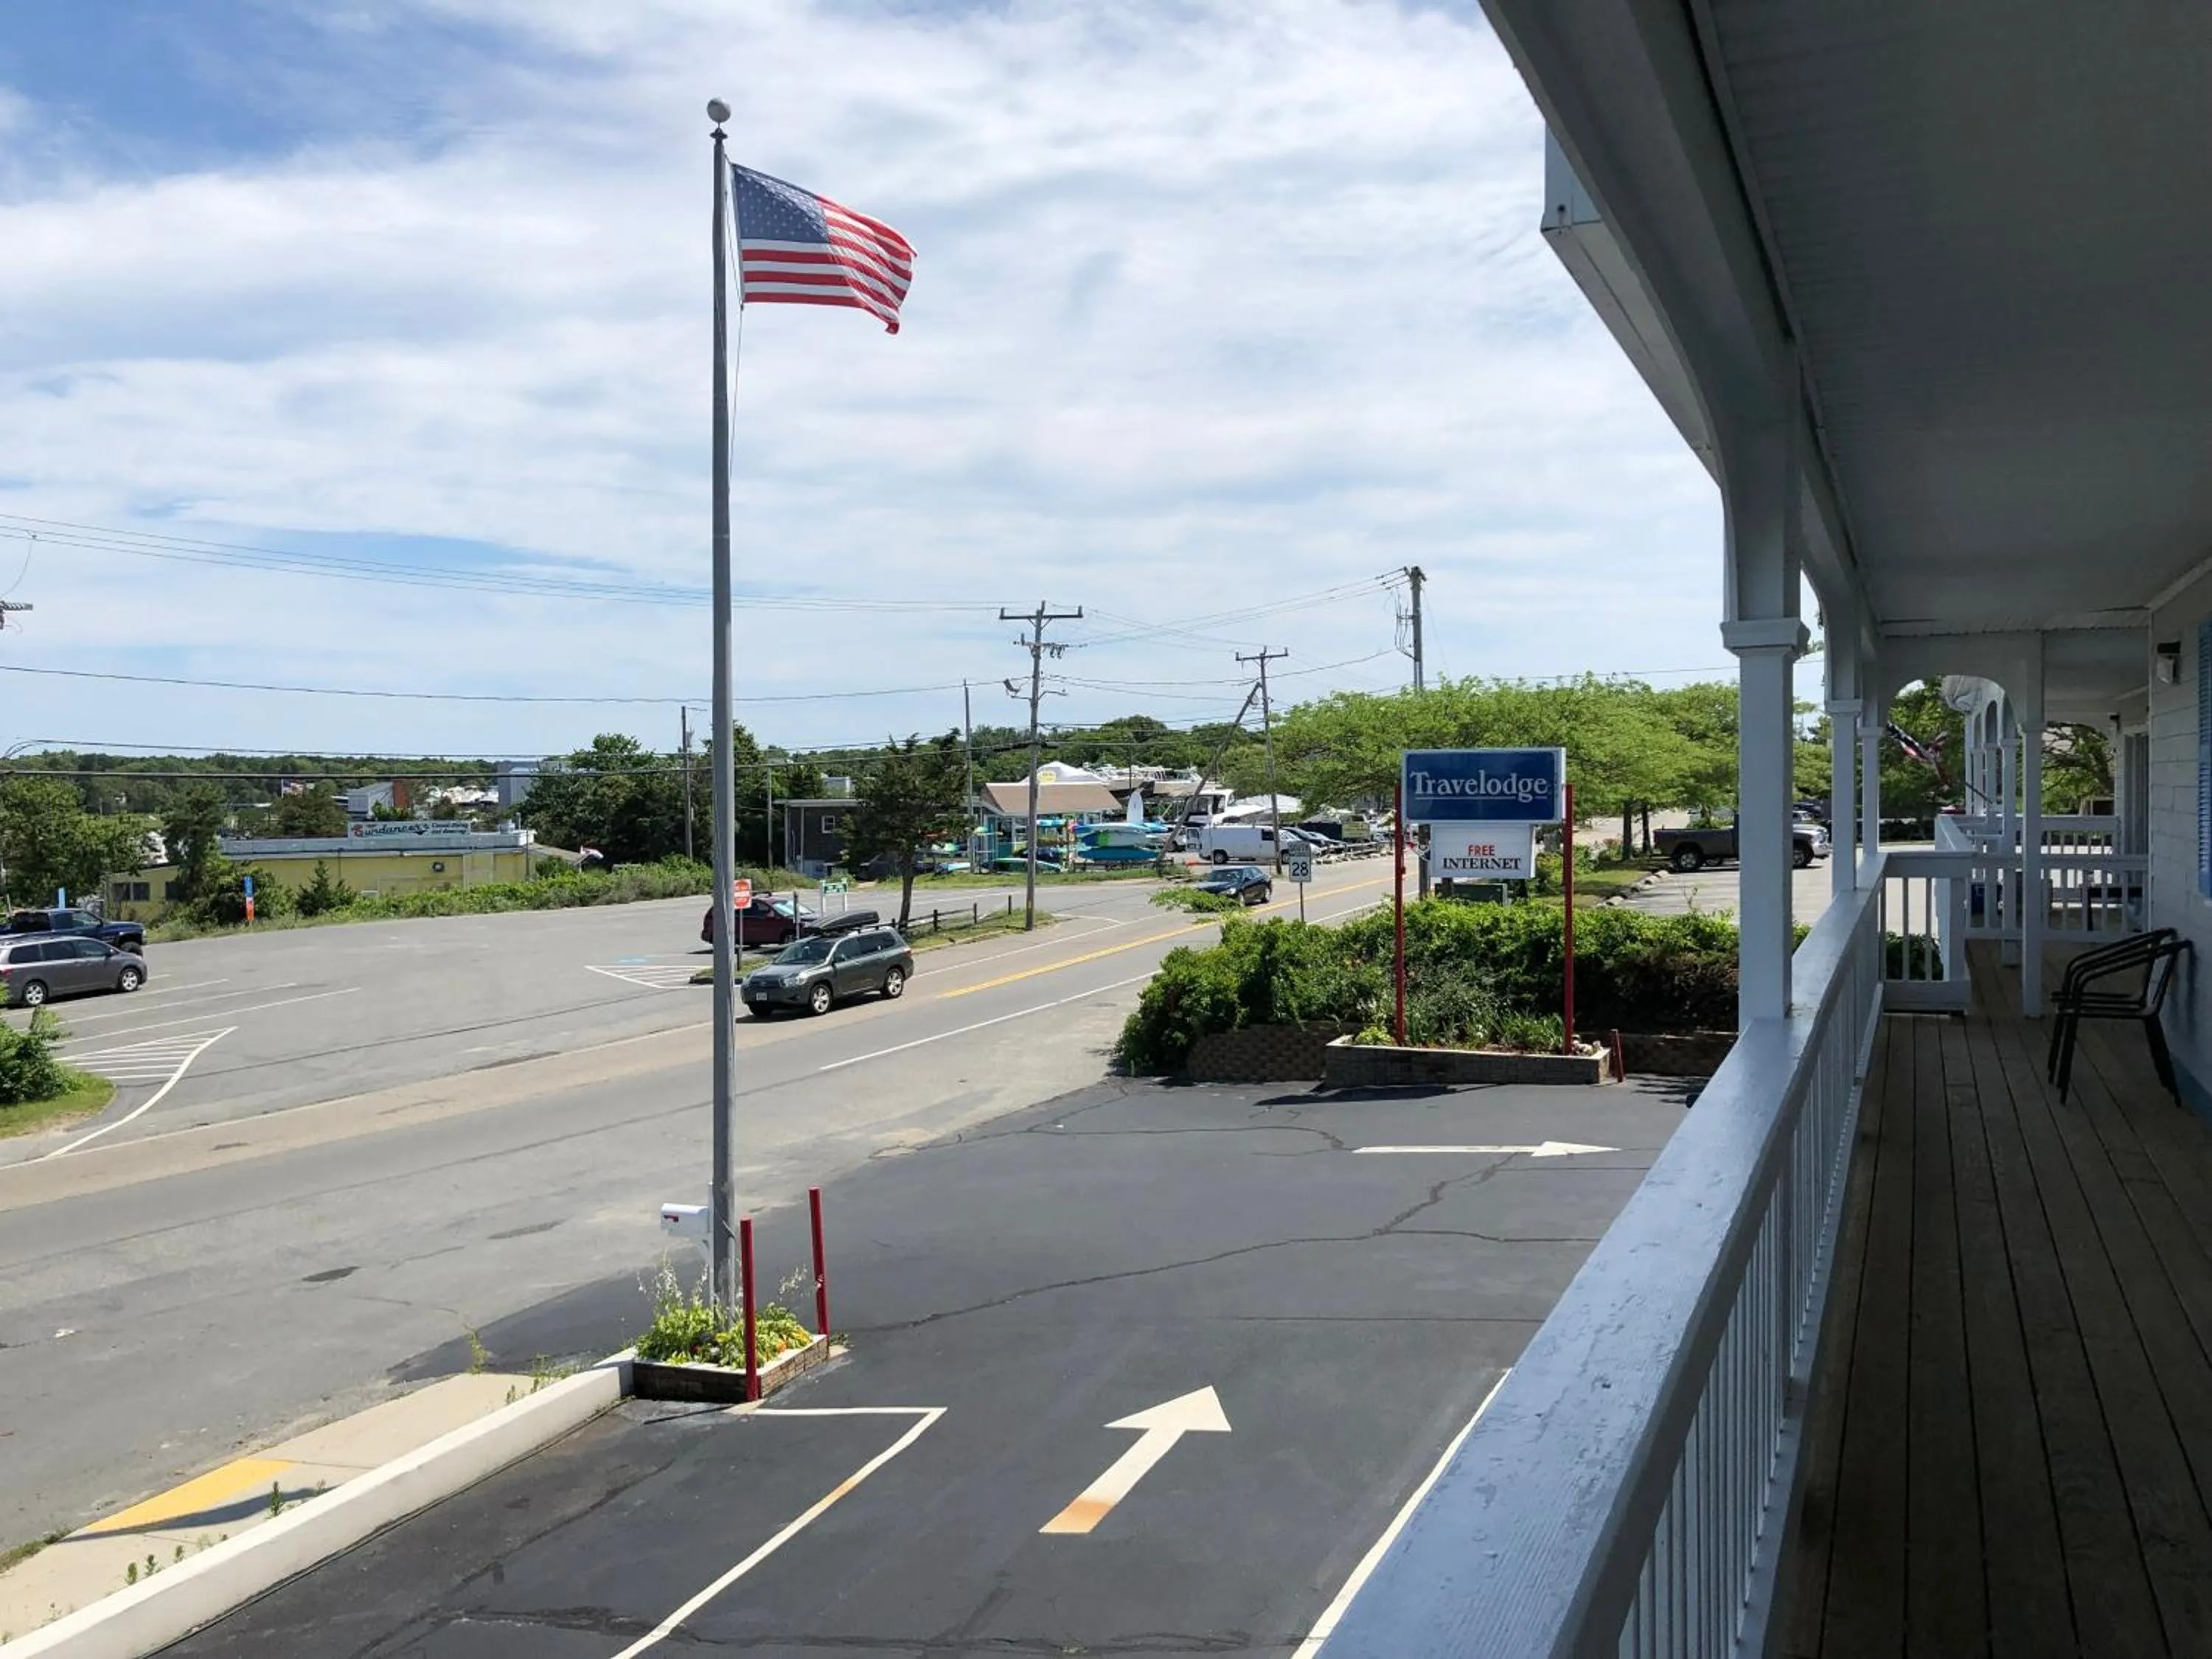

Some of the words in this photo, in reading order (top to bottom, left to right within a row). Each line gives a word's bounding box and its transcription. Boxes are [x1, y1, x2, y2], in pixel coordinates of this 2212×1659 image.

[1410, 770, 1548, 803] Travelodge
[1467, 845, 1495, 856] FREE
[1292, 862, 1309, 877] 28
[1443, 858, 1521, 869] INTERNET
